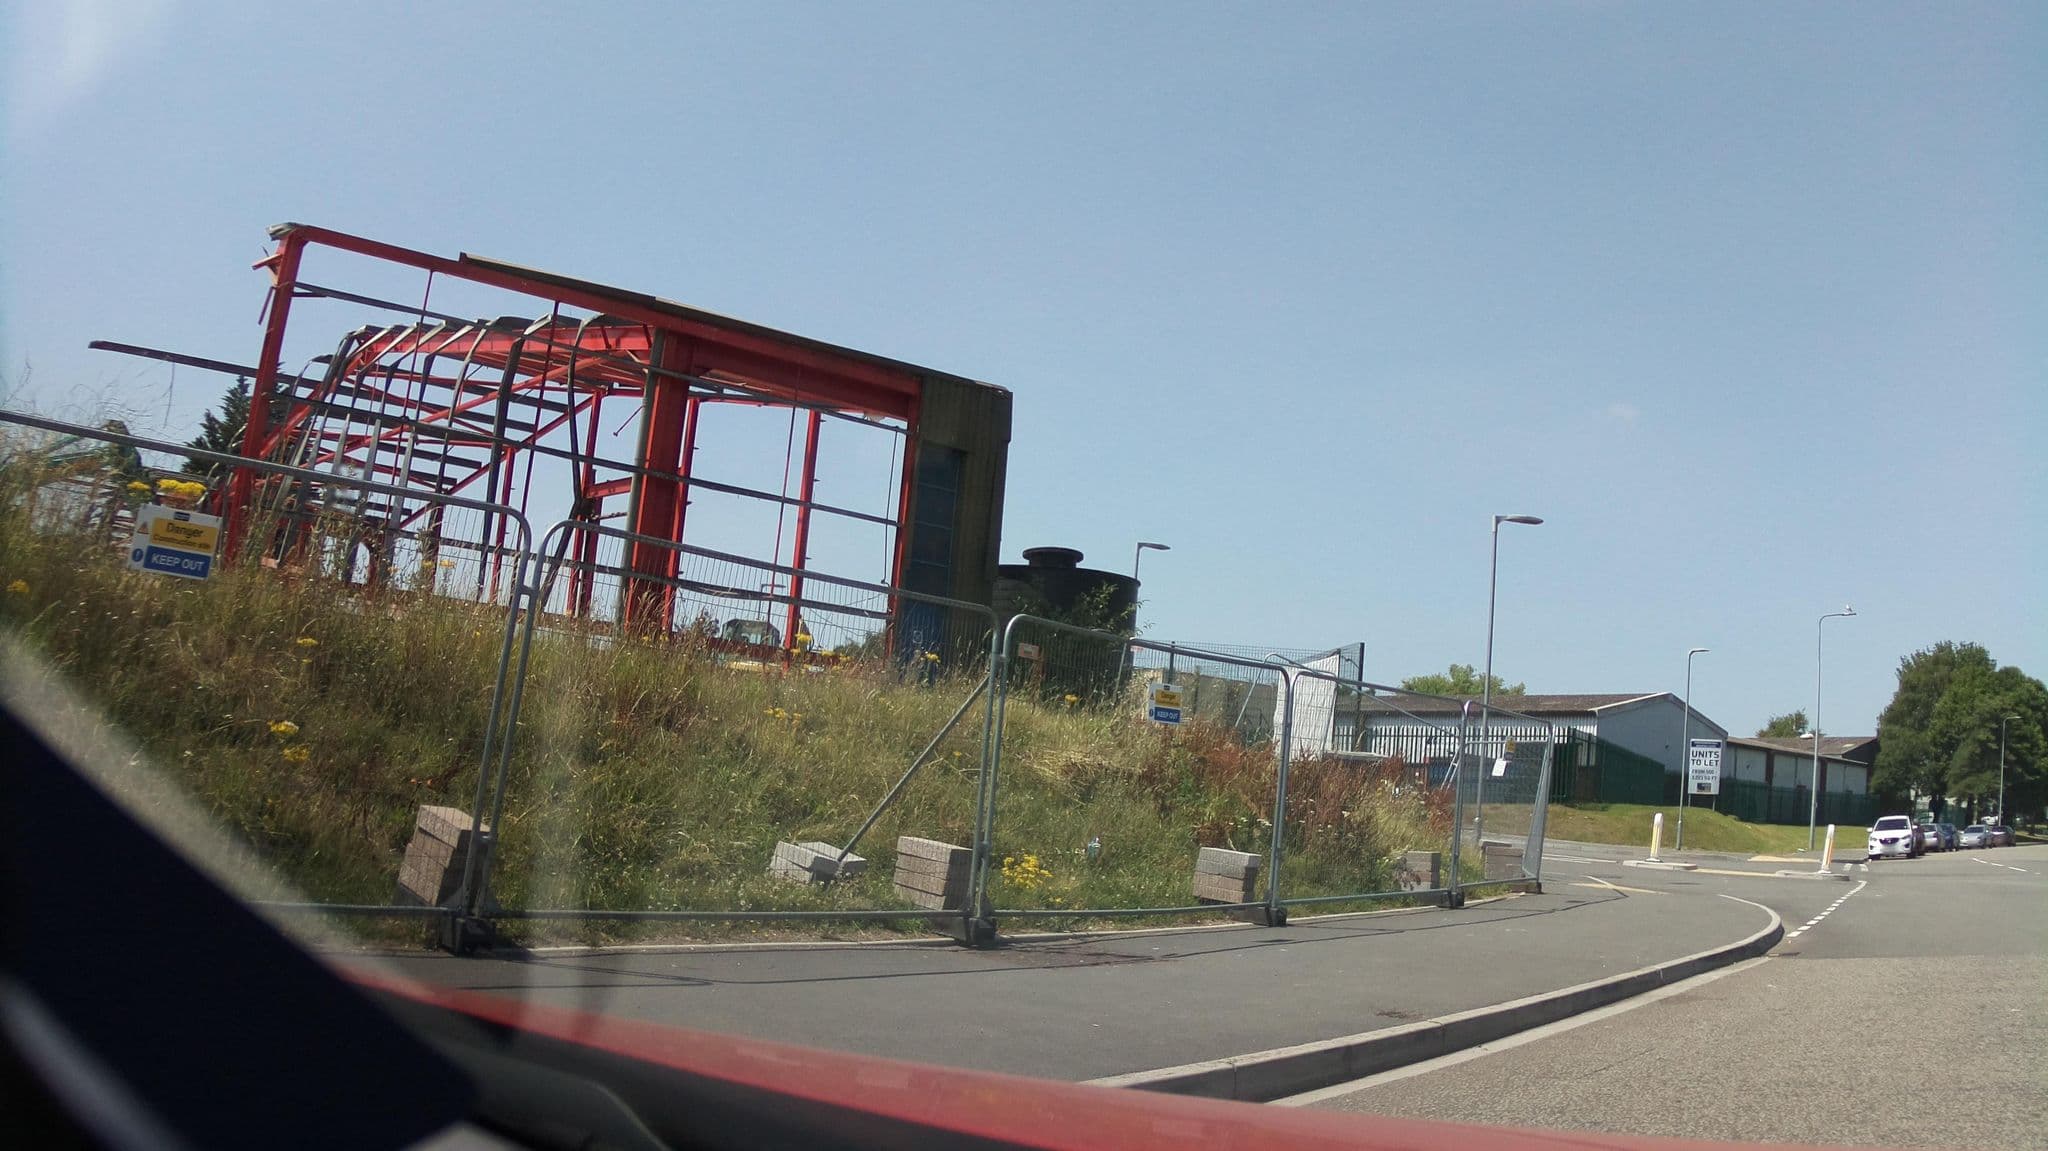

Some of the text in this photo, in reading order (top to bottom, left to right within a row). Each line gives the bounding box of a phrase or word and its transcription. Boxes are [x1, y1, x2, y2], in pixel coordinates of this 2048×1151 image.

[167, 522, 204, 539] Danger
[151, 552, 205, 572] KEEP OUT
[1691, 750, 1720, 759] UNITS
[1690, 758, 1720, 767] TO LET
